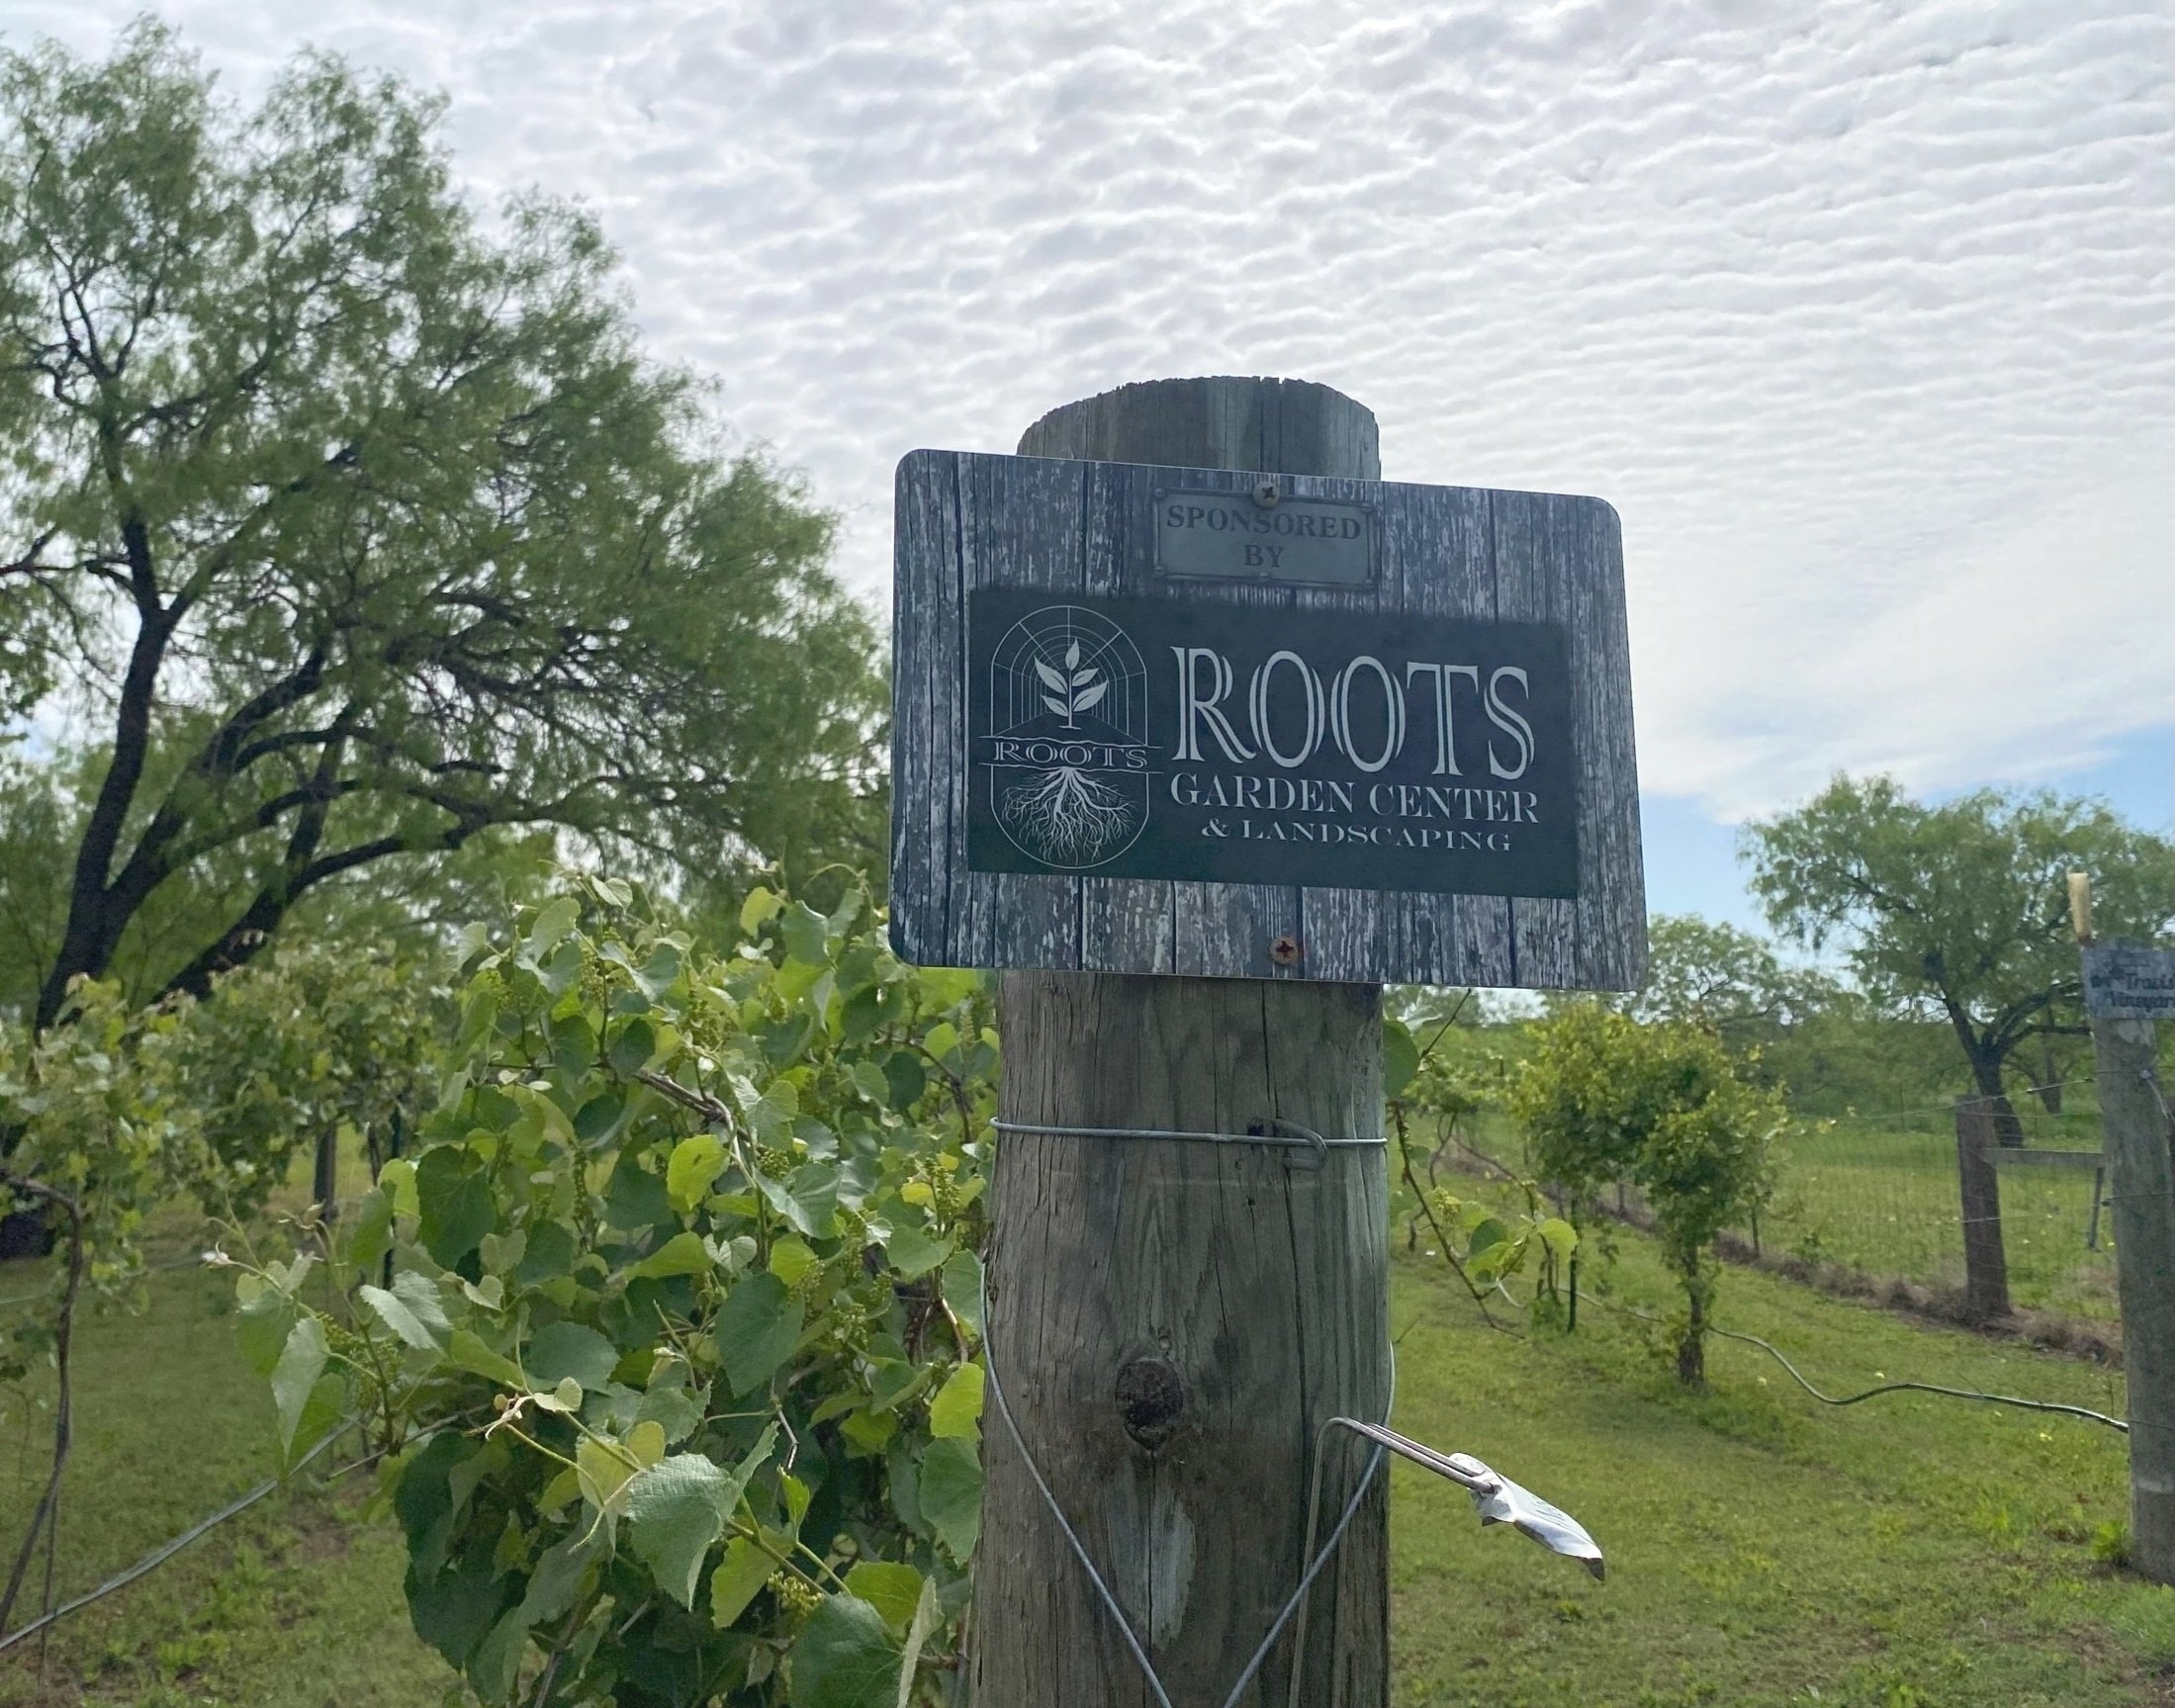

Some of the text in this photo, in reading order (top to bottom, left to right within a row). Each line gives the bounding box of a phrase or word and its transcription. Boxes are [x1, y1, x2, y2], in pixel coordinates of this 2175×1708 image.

[1166, 504, 1361, 540] SPONSORED
[1243, 544, 1285, 568] BY
[1170, 645, 1536, 780] ROOTS
[994, 741, 1147, 768] ROOTS
[1170, 771, 1540, 824] GARDEN CENTER
[1202, 817, 1511, 852] & LANDSCAPING
[2106, 990, 2175, 1013] Vineyar
